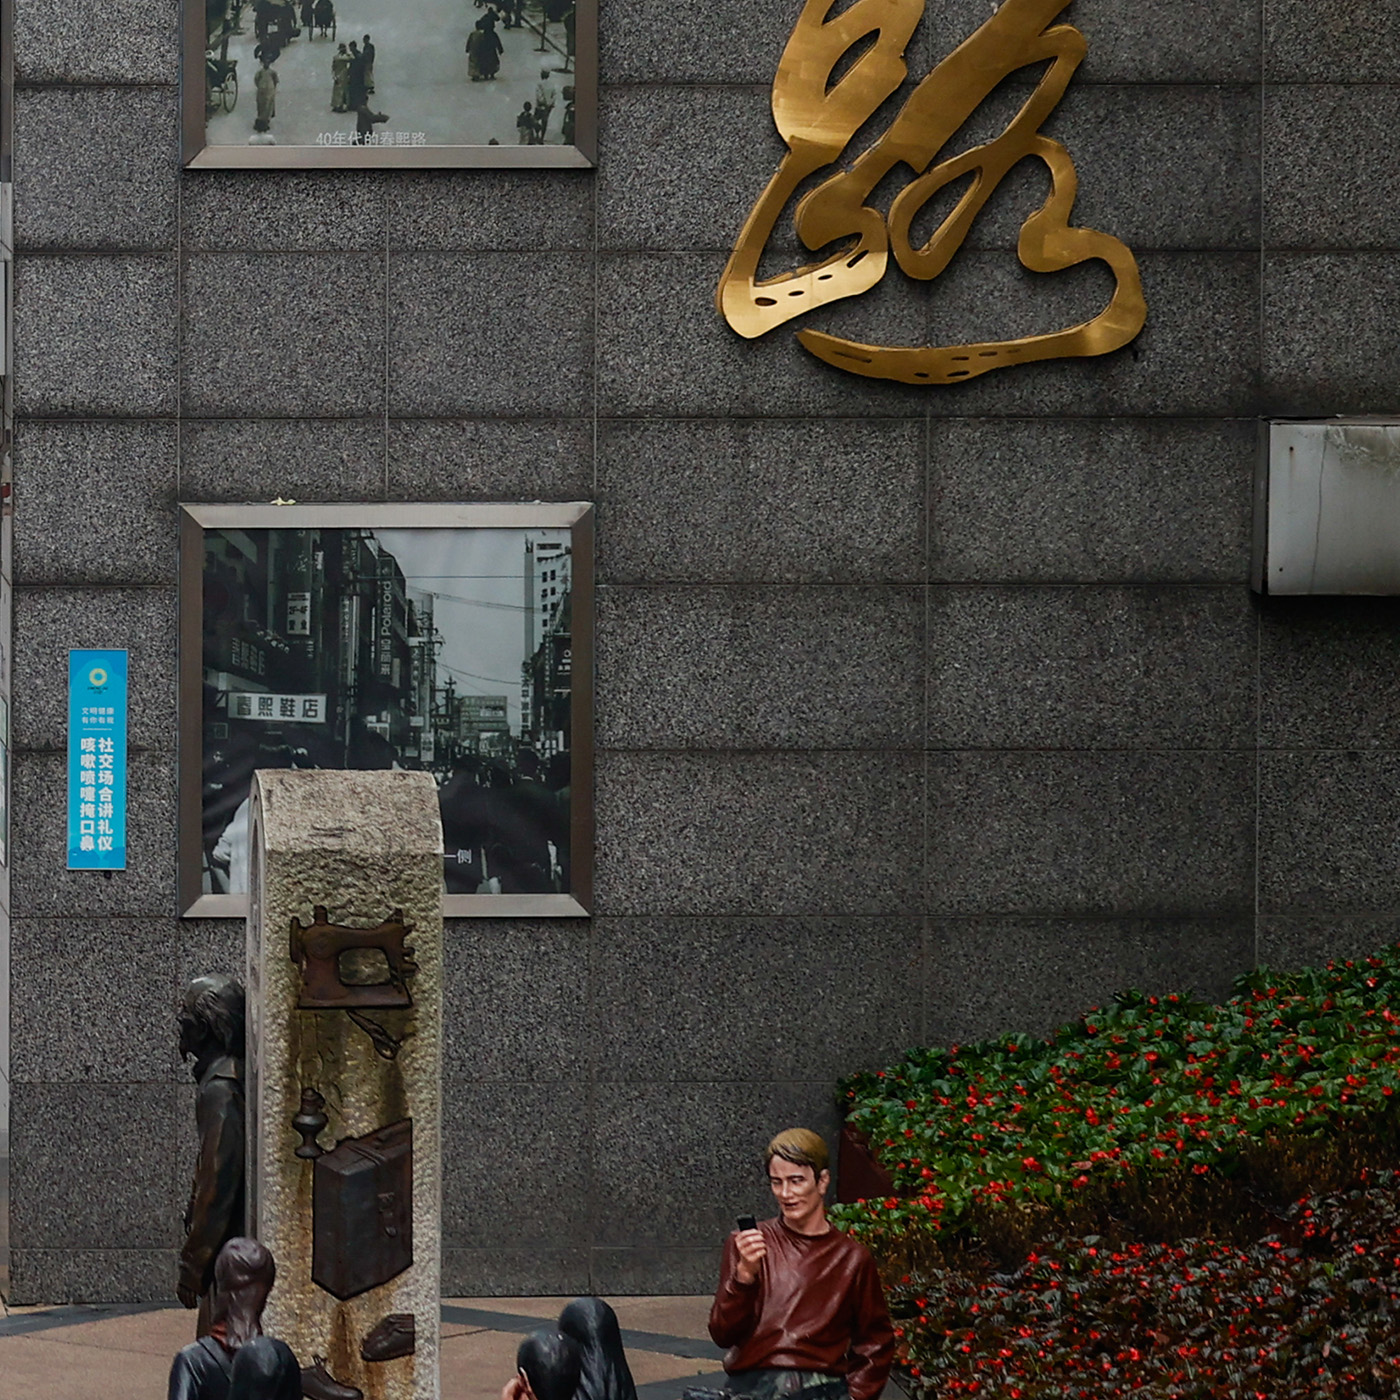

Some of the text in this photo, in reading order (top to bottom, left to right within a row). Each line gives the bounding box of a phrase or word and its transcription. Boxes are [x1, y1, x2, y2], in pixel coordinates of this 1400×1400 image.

[316, 131, 427, 146] 40年代的春熙路
[79, 737, 97, 852] 咳嗽喷嚏掩口鼻
[97, 737, 115, 851] 社交场合讲礼仪
